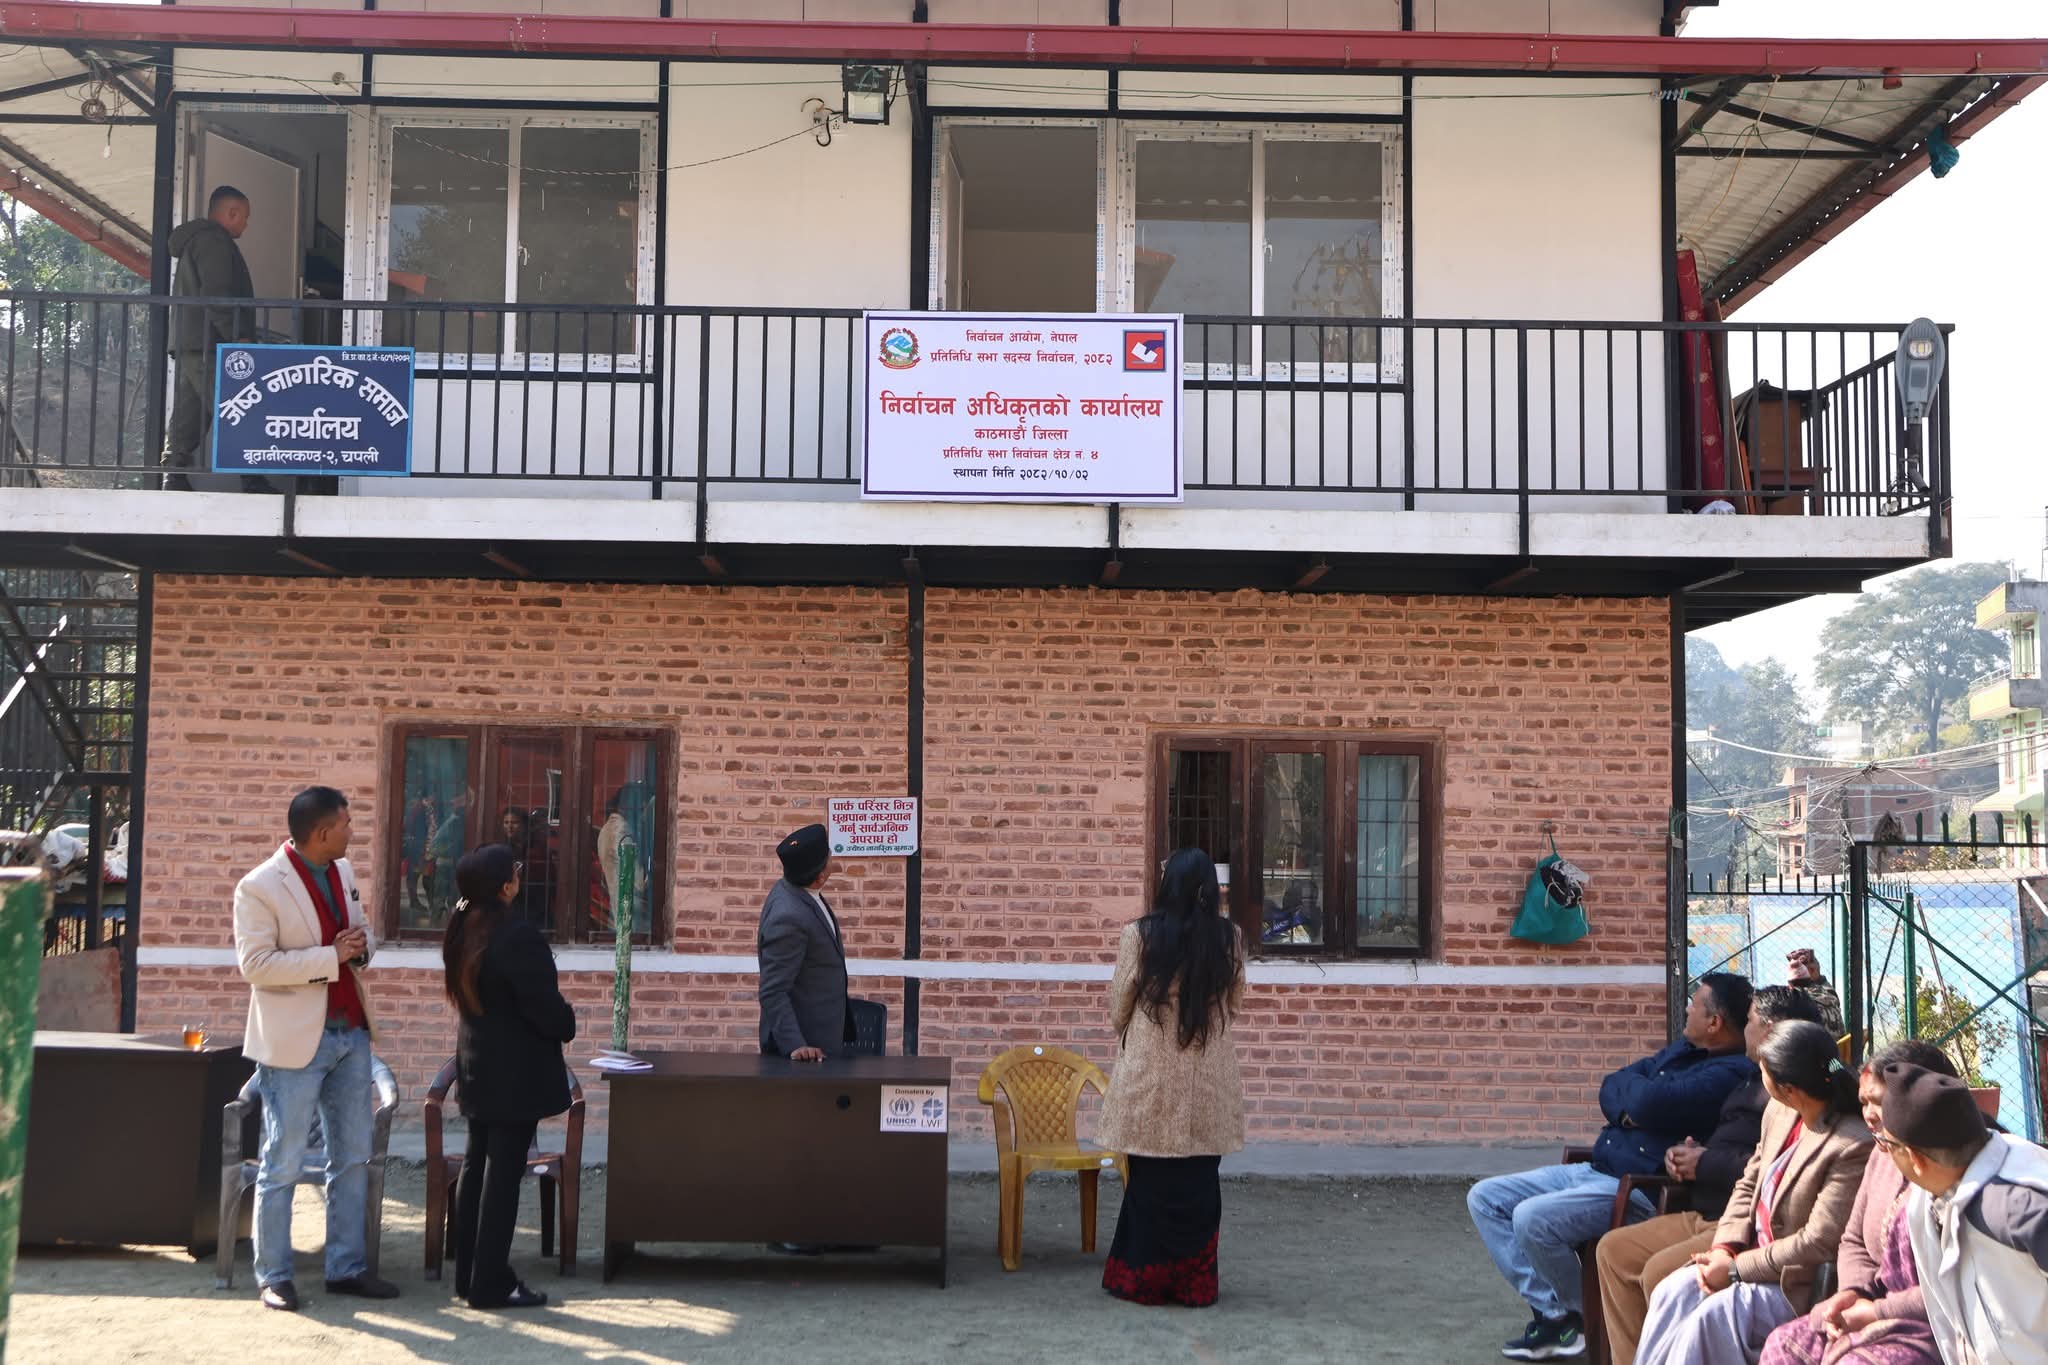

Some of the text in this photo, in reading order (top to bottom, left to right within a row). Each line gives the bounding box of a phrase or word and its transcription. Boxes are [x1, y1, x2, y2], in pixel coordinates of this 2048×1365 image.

[966, 329, 1078, 344] निर्वाचन आयोग, नेपाल
[930, 348, 1113, 366] प्रतिनिधि सभा सदस्य निर्वाचन, २०८२
[261, 355, 359, 393] नागरिक
[358, 376, 409, 428] समाज
[880, 390, 1163, 423] निर्वाचन अधिकृतको कार्यालय
[265, 407, 361, 440] कार्यालय
[974, 425, 1069, 441] काठमाडौं जिल्ला
[341, 446, 379, 465] चपली
[943, 447, 982, 460] प्रतिनिधि
[988, 449, 1007, 459] सभा
[1012, 447, 1048, 460] निर्वाचन
[1053, 448, 1070, 460] क्षेत्र
[1091, 451, 1099, 460] ४
[953, 466, 1089, 481] स्थापना मिति २०८२/१०/०२
[832, 800, 854, 810] पार्क
[893, 799, 914, 810] भित्र
[839, 821, 909, 834] गर्नु सार्वजनिक
[849, 833, 898, 844] अपराध हो
[925, 1088, 935, 1096] by
